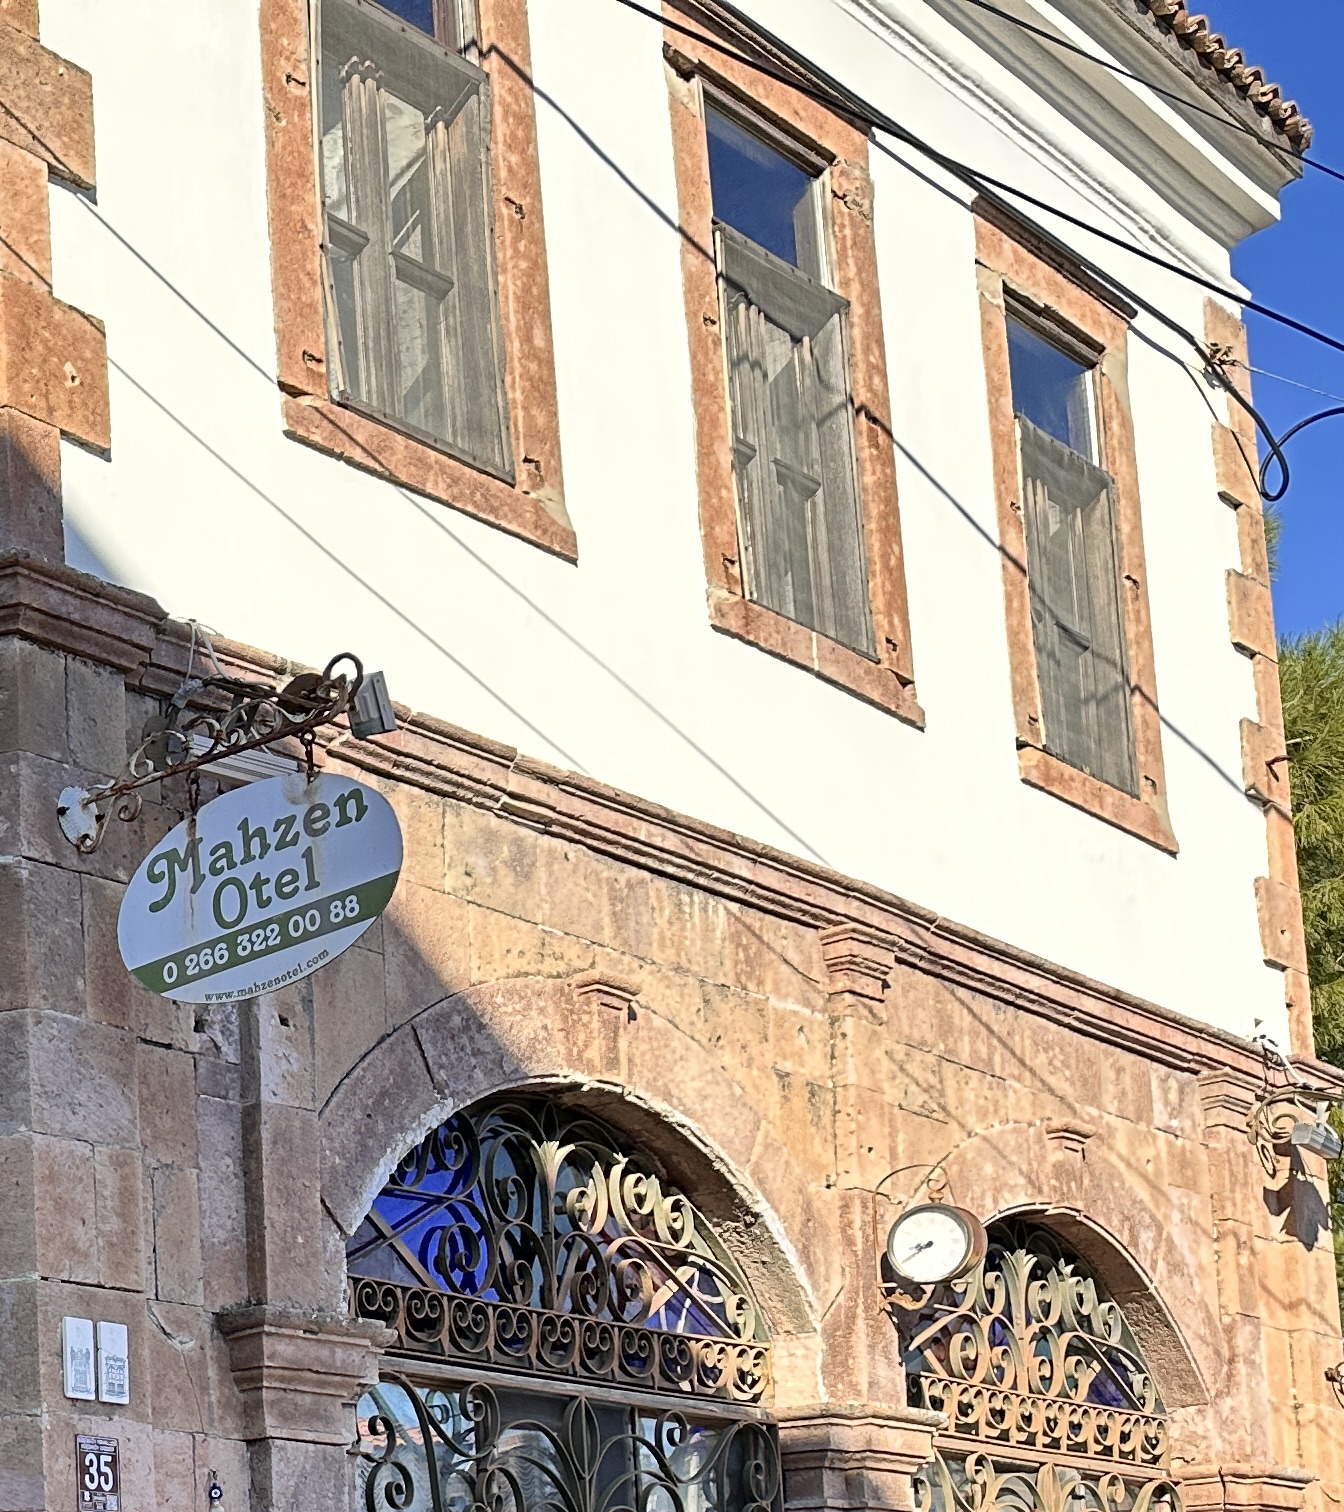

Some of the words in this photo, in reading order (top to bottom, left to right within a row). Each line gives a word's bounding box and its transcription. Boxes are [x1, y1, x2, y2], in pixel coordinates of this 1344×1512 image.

[146, 788, 369, 913] Mahzen
[212, 846, 321, 930] Otel
[163, 961, 178, 983] 0
[184, 942, 229, 976] 266
[236, 923, 281, 957] 322
[288, 909, 321, 938] 00
[329, 894, 360, 923] 88
[204, 949, 330, 1002] www.mahzenotel.com
[84, 1452, 114, 1492] 35
